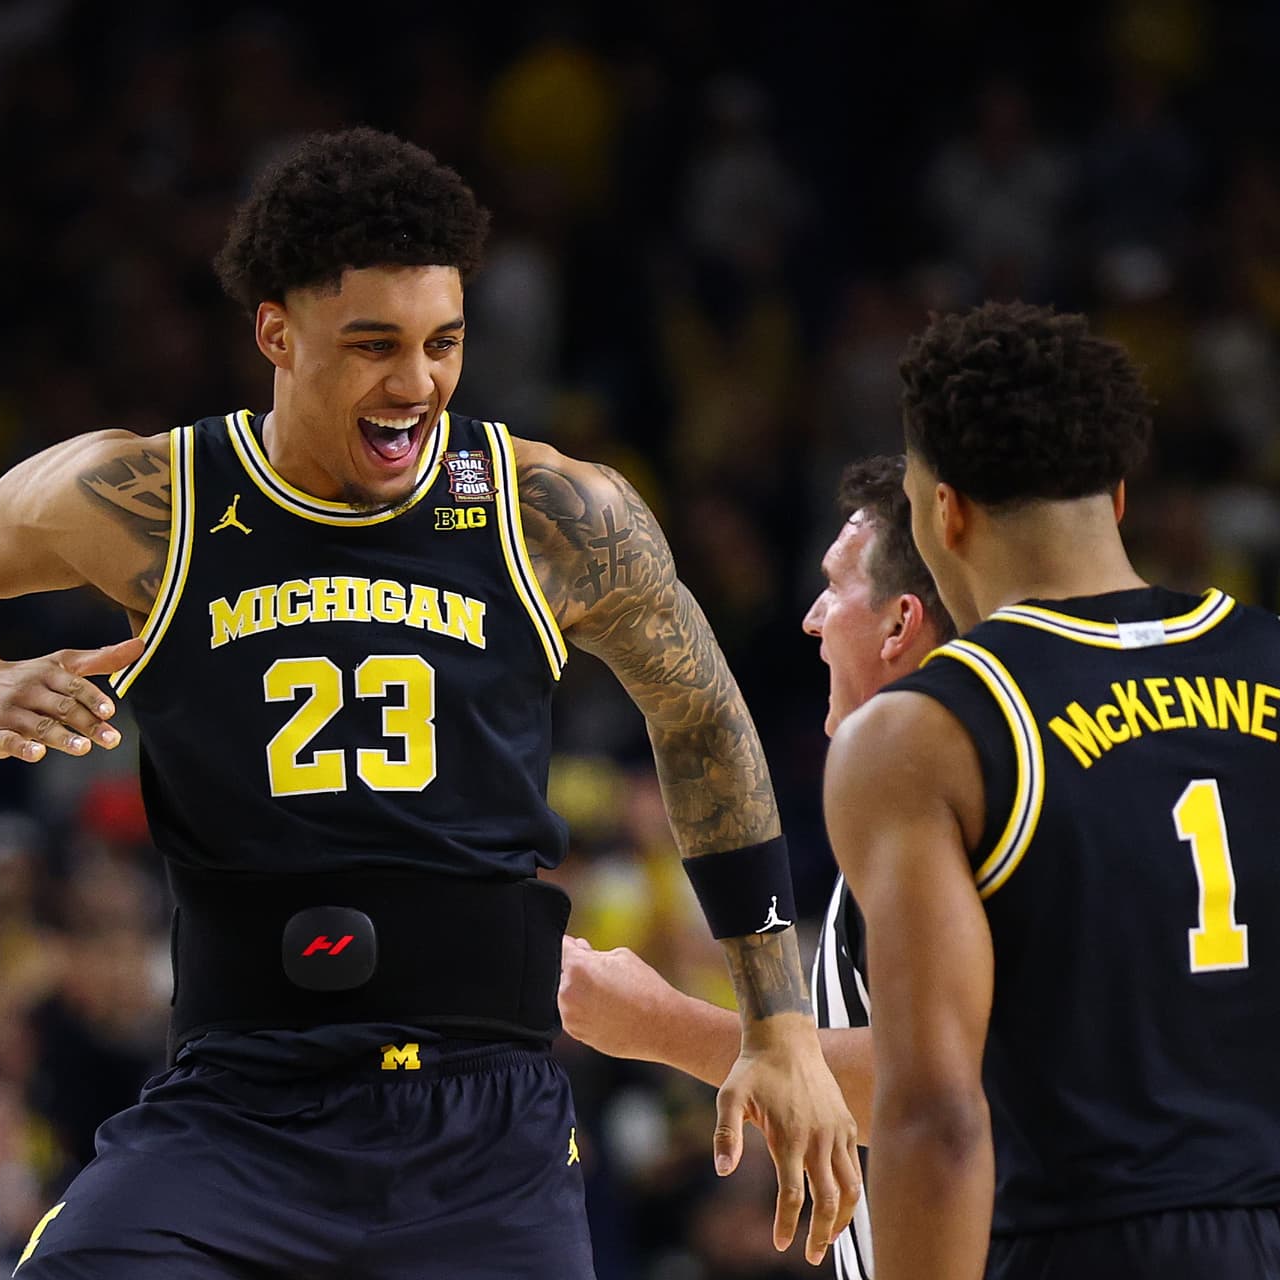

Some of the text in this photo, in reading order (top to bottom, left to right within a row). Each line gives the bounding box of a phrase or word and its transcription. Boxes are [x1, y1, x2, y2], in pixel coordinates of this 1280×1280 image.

[448, 459, 484, 471] FINAL
[455, 482, 490, 494] FOUR
[208, 575, 487, 650] MICHIGAN
[262, 653, 437, 797] 23
[1172, 778, 1250, 974] 1
[380, 1042, 422, 1071] M
